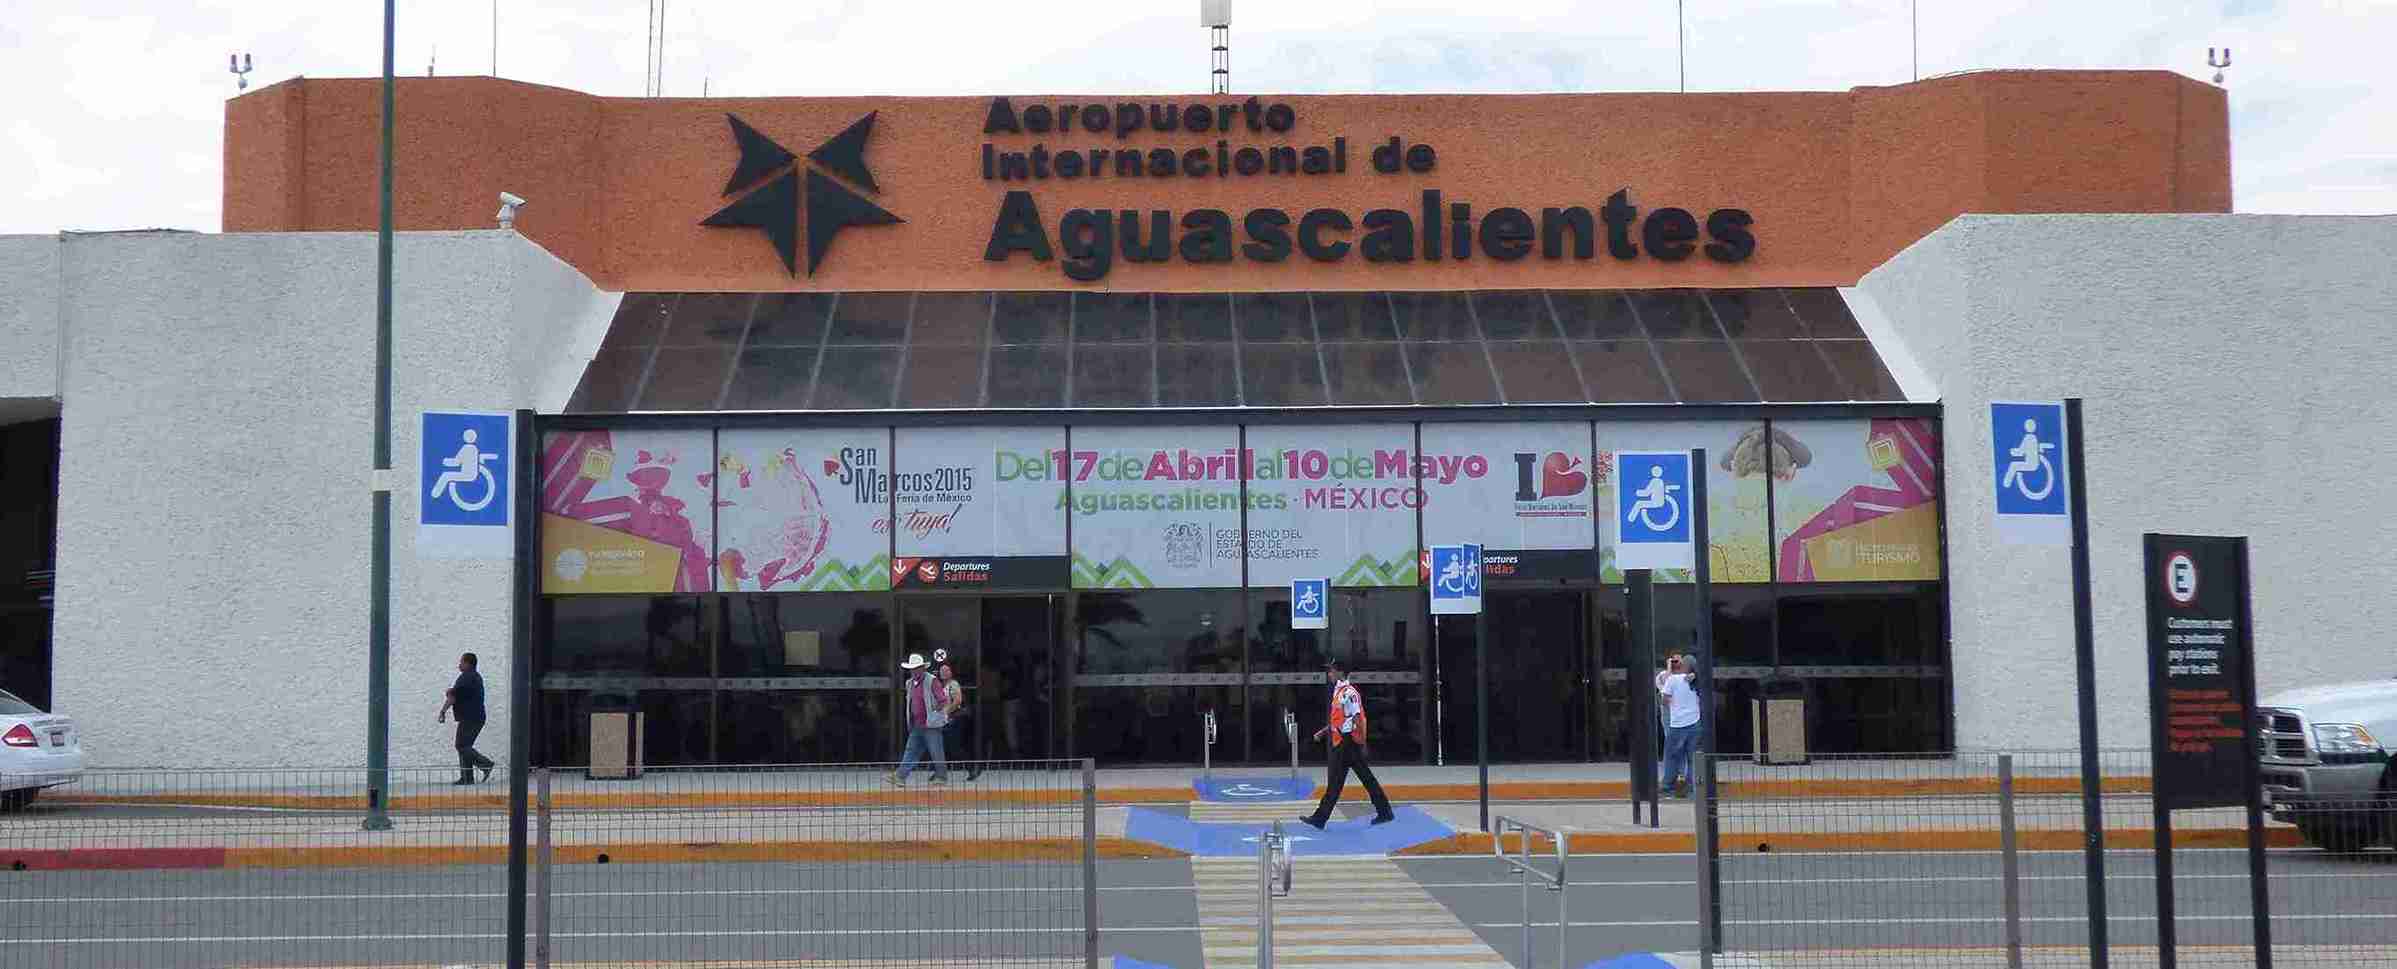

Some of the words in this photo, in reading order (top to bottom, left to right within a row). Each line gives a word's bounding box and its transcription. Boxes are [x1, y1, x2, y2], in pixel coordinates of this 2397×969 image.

[983, 96, 1296, 139] Aeropuerto
[982, 137, 1347, 179] Internacional
[1373, 137, 1436, 173] de
[984, 186, 1755, 281] Aguascalientes
[839, 446, 877, 485] San
[1054, 487, 1288, 515] Aguascalientes
[1305, 482, 1429, 510] MÉXICO
[1216, 529, 1280, 539] GOBERNO
[943, 561, 991, 572] Departures
[944, 572, 988, 582] Salidas
[2174, 563, 2189, 593] E
